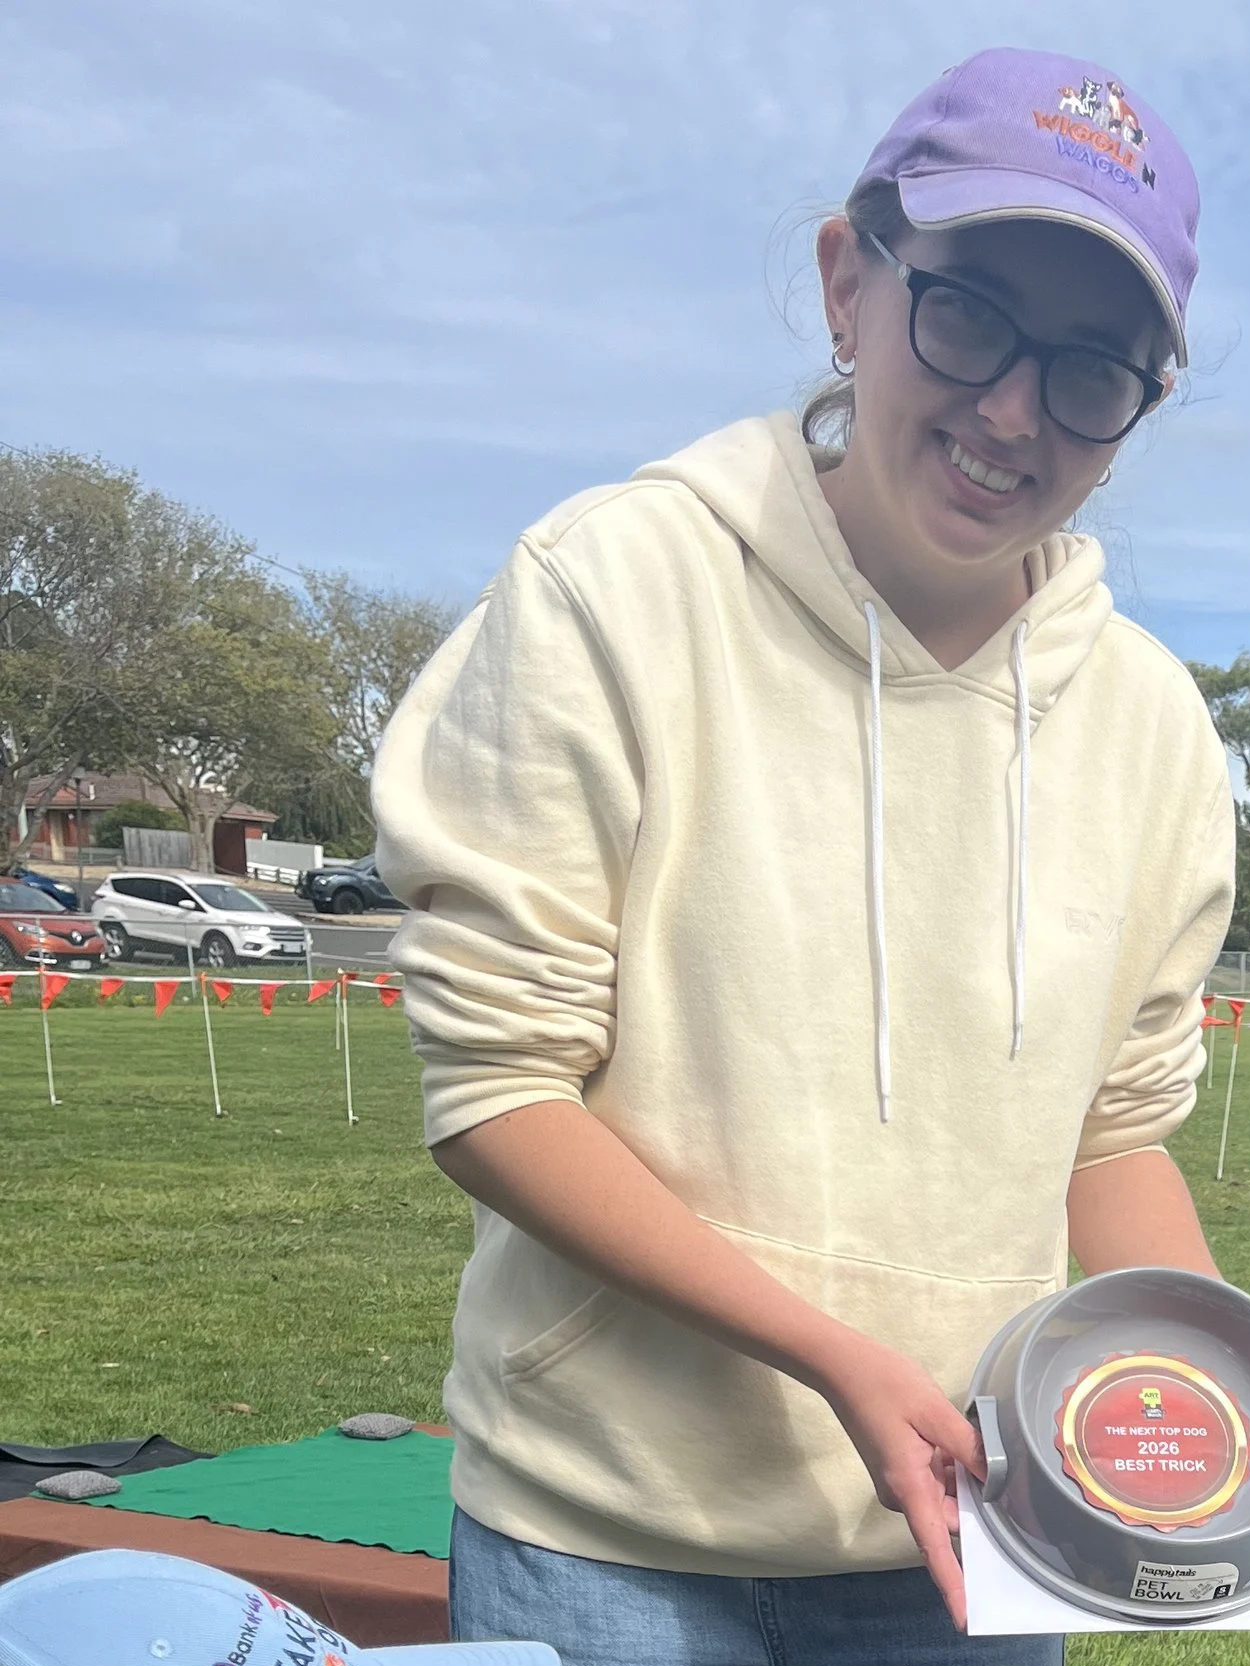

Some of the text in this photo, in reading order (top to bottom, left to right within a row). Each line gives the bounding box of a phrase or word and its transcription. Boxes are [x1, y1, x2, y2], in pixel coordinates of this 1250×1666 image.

[1032, 110, 1138, 173] WIGGLE
[1105, 1426, 1208, 1436] THE NEXT TOP DOG
[1137, 1441, 1180, 1455] 2026
[1114, 1458, 1207, 1472] BEST TRICK
[1137, 1579, 1169, 1591] PET
[1134, 1588, 1185, 1601] BOWL
[227, 1622, 259, 1666] Bank
